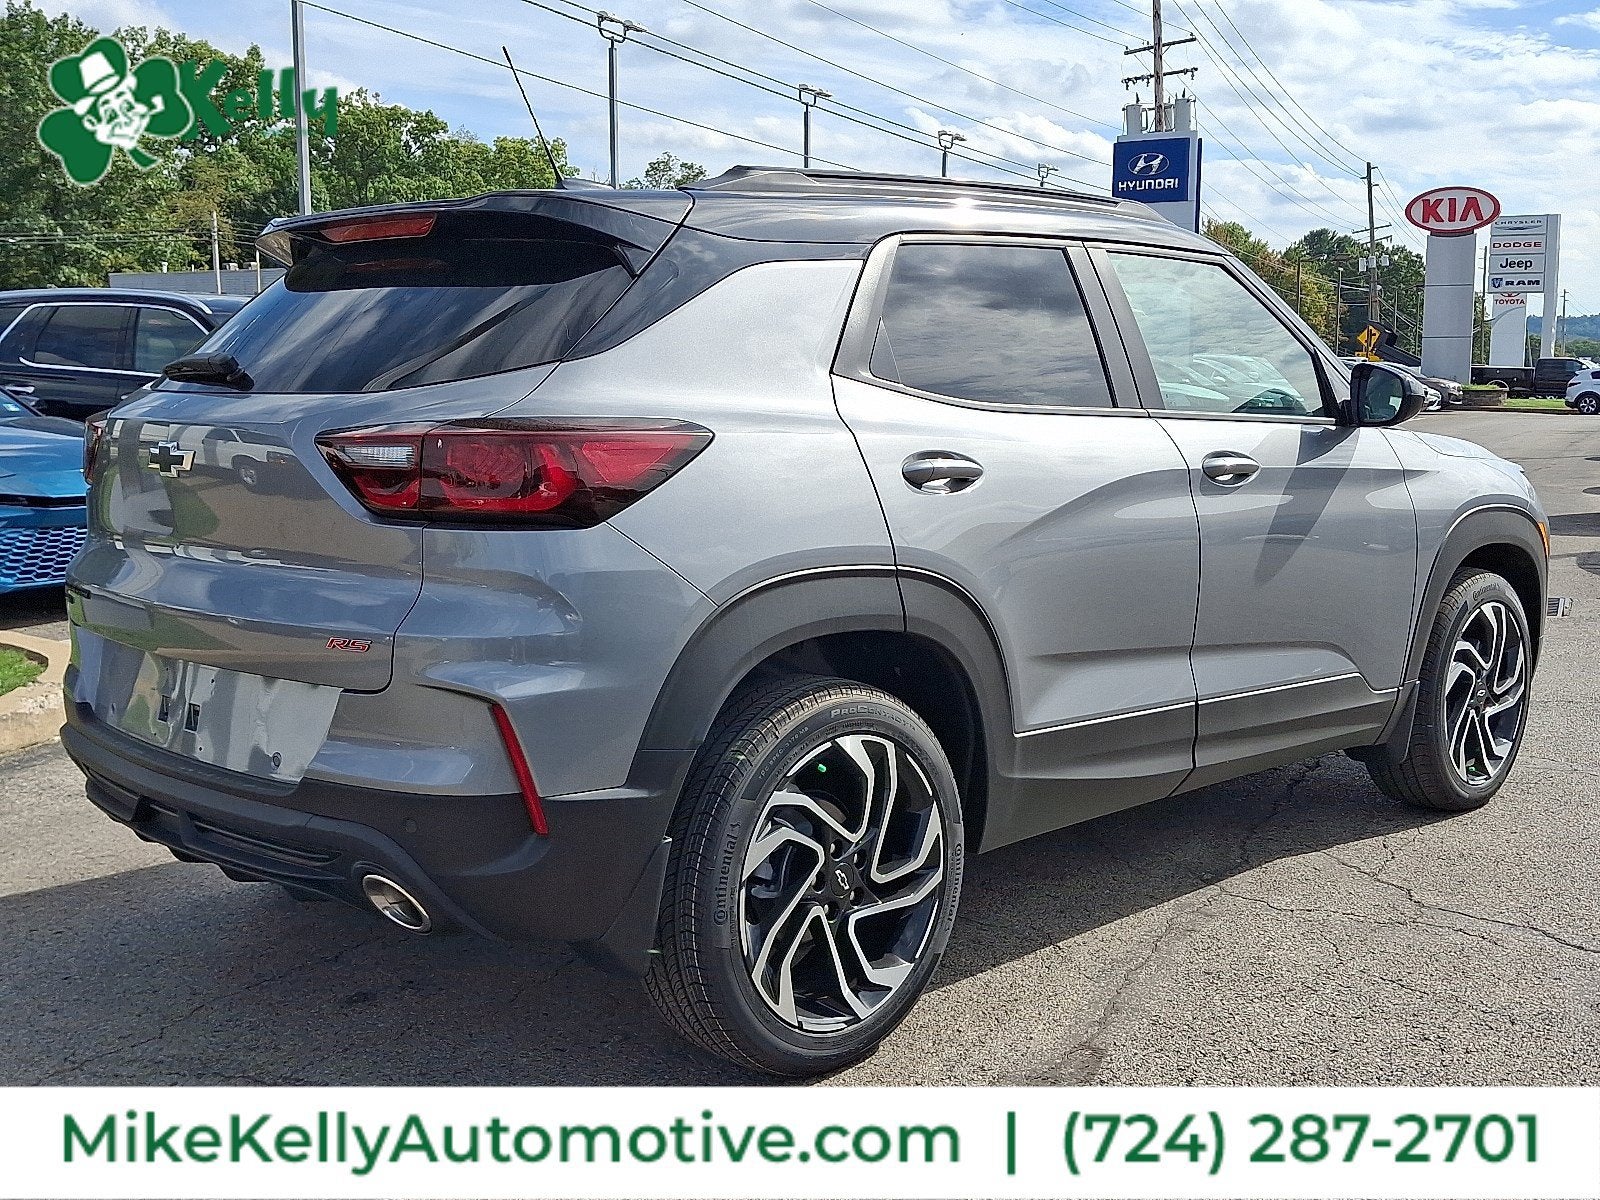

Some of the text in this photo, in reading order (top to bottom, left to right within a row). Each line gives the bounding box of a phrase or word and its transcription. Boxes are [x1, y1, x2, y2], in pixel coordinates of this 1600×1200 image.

[1118, 178, 1179, 191] HYUNDAI
[1421, 196, 1485, 223] KIA
[1492, 241, 1543, 249] DODGE
[1499, 257, 1533, 271] Jeep
[1504, 279, 1541, 287] RAM
[326, 636, 372, 653] RS
[714, 833, 738, 926] Continental
[947, 843, 962, 922] Continental
